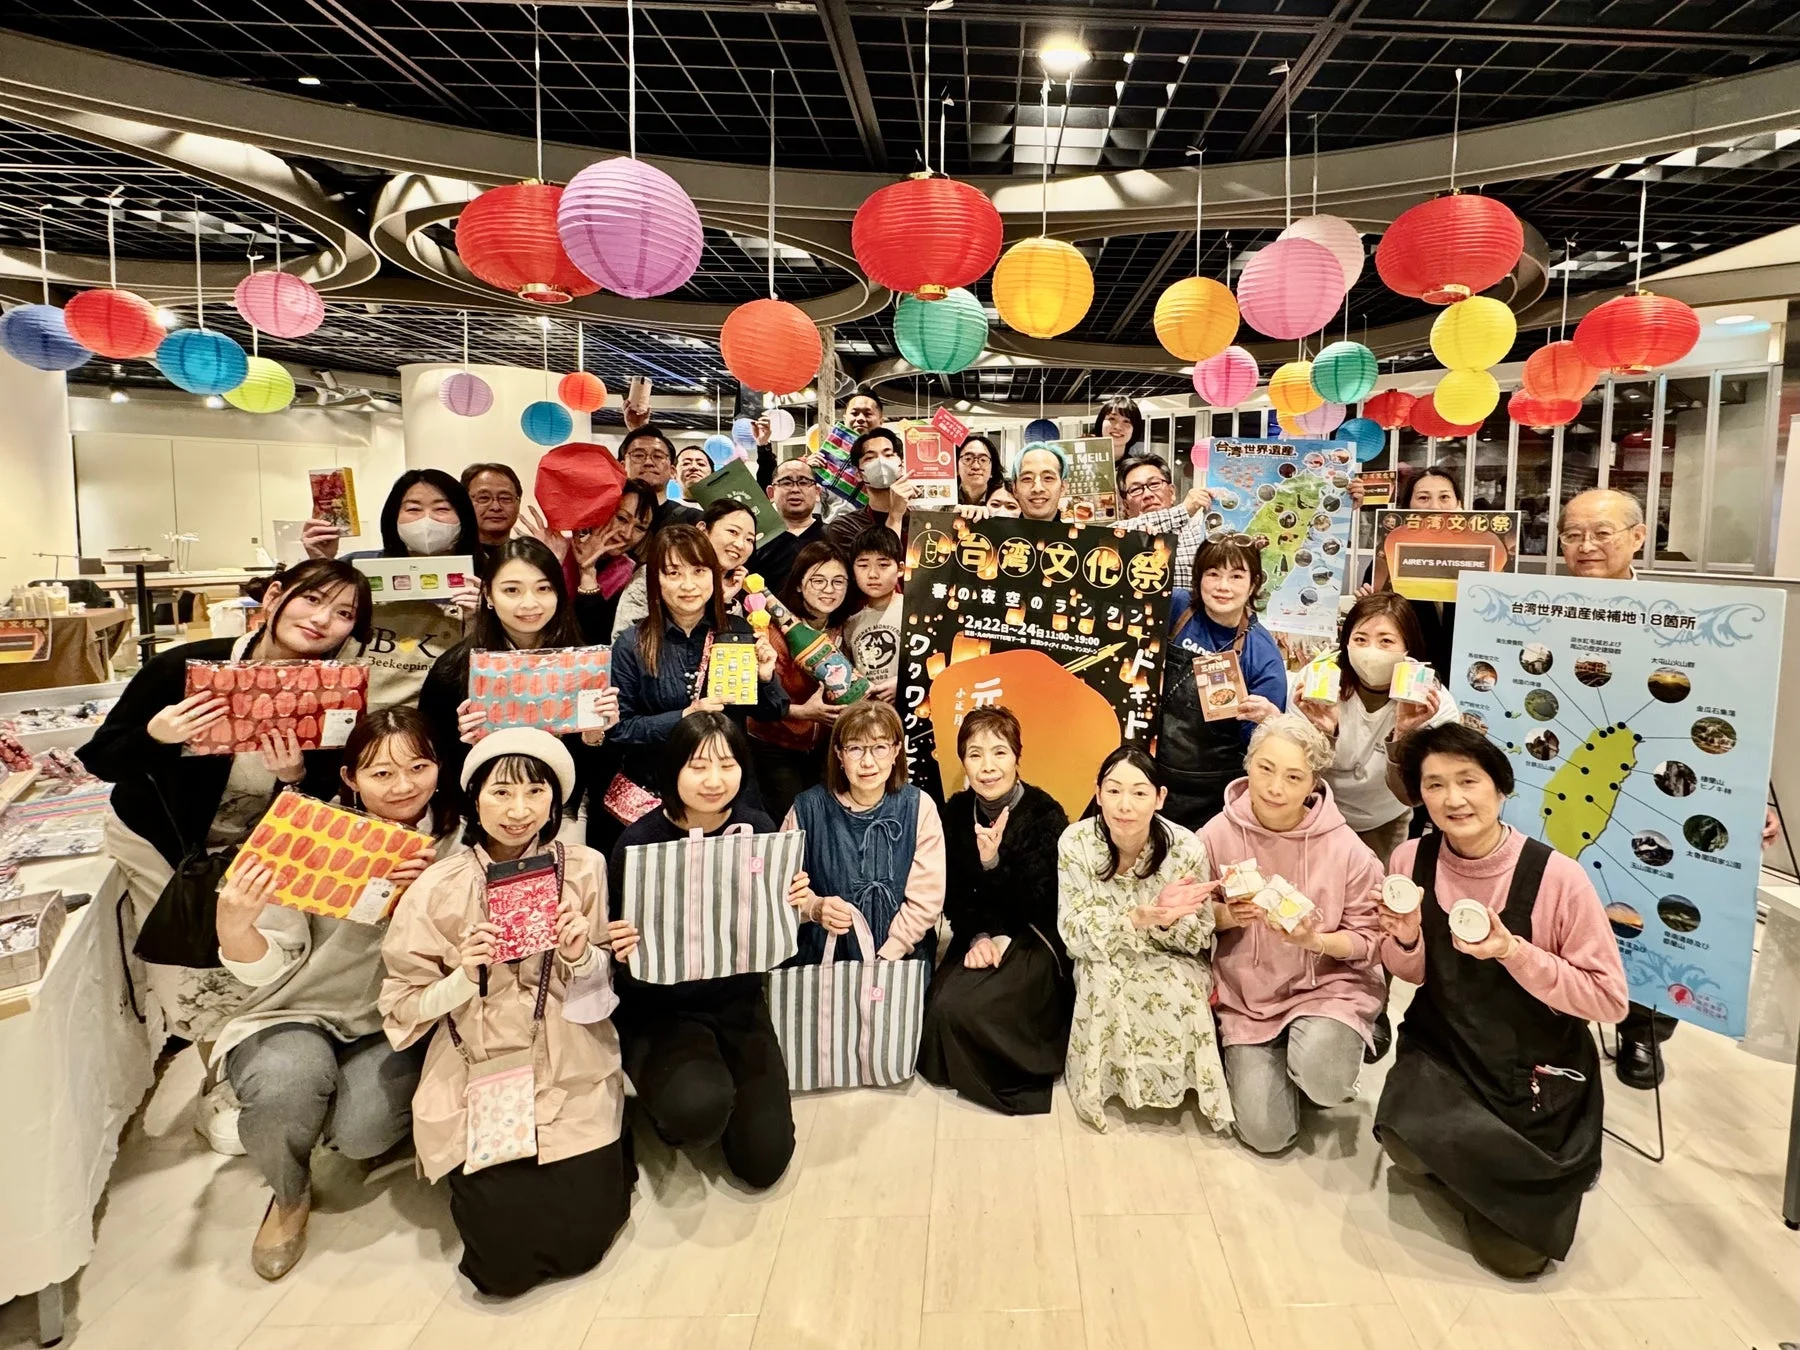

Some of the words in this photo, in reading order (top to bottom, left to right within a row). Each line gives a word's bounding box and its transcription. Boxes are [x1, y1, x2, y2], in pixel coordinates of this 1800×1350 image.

[1405, 514, 1511, 533] 台湾文化祭
[959, 532, 1168, 592] 台湾文化祭
[1402, 558, 1434, 566] AIREY'S
[1436, 559, 1485, 568] PATISSIERE
[931, 583, 1143, 623] 春の夜空のランタン
